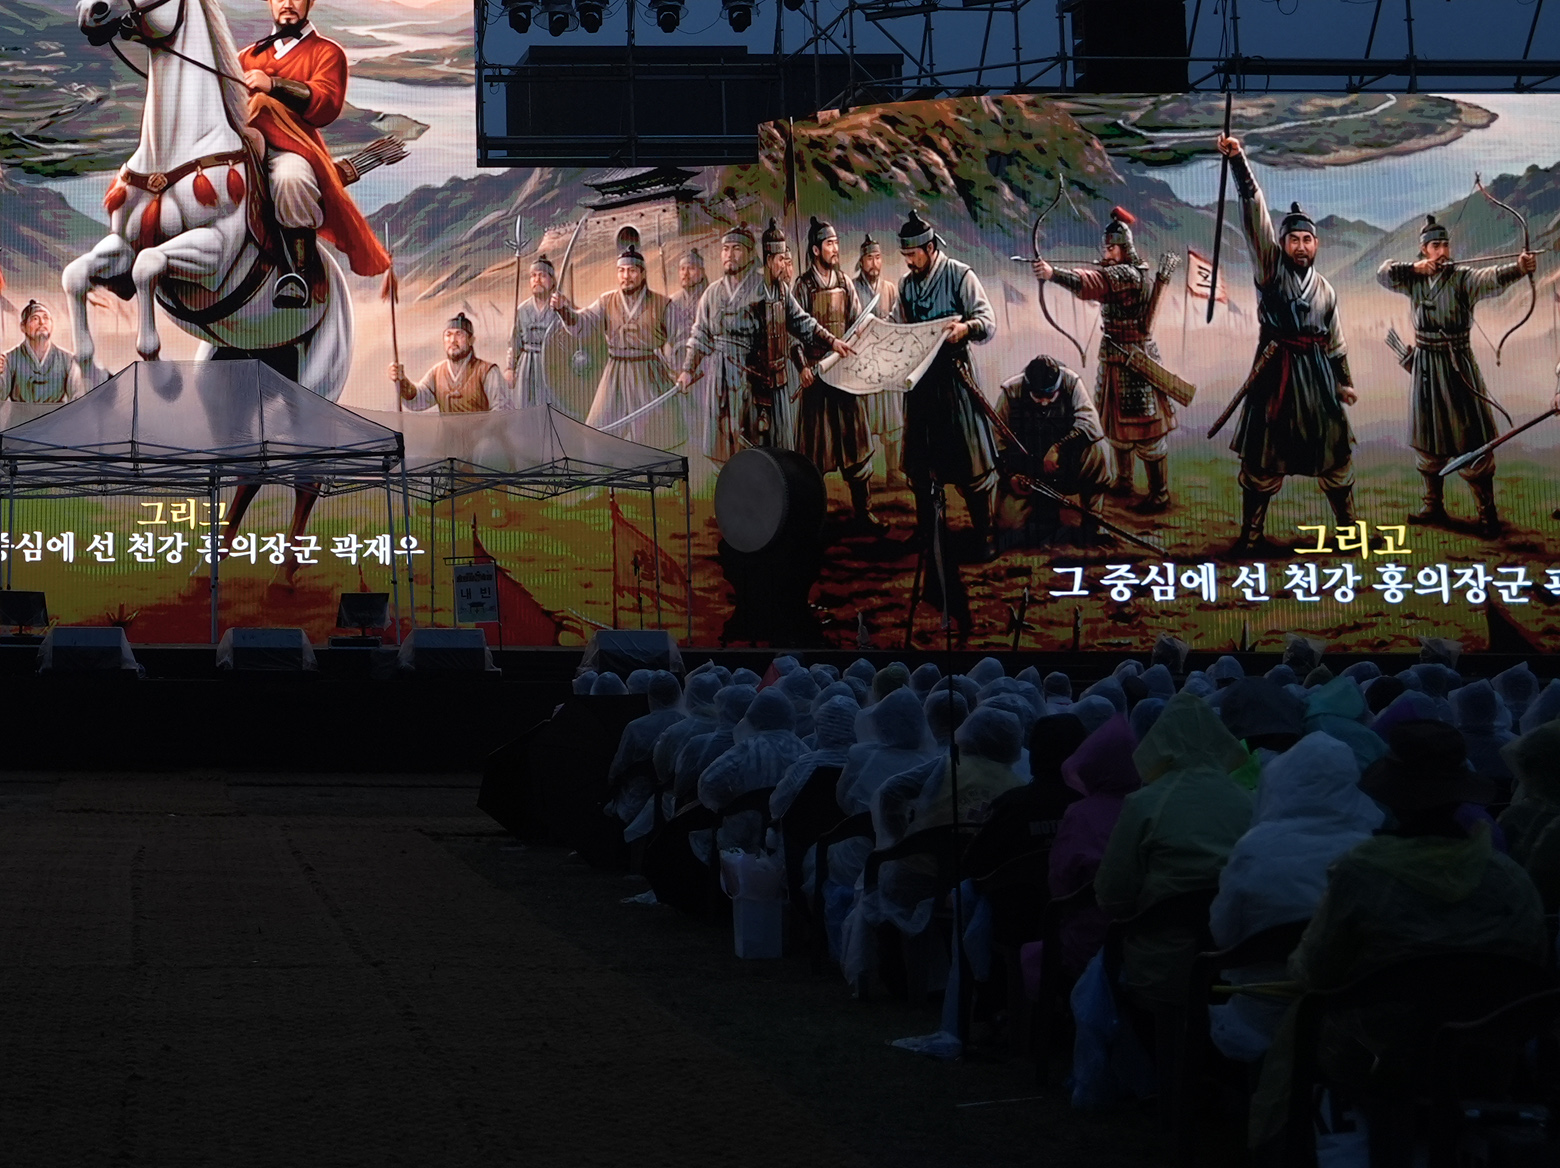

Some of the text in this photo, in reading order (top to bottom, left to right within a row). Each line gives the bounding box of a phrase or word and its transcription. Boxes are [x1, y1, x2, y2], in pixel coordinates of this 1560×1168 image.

[136, 498, 230, 530] 그리고
[85, 531, 116, 562] 선
[126, 531, 189, 564] 천강
[196, 532, 323, 565] 홍의장군
[329, 533, 425, 566] 곽재우
[1293, 520, 1412, 560] 그리고
[1048, 566, 1089, 597] 그
[1099, 562, 1217, 603] 중심에
[1231, 562, 1270, 601] 선
[1283, 562, 1363, 603] 천강
[1371, 563, 1533, 604] 홍의장군
